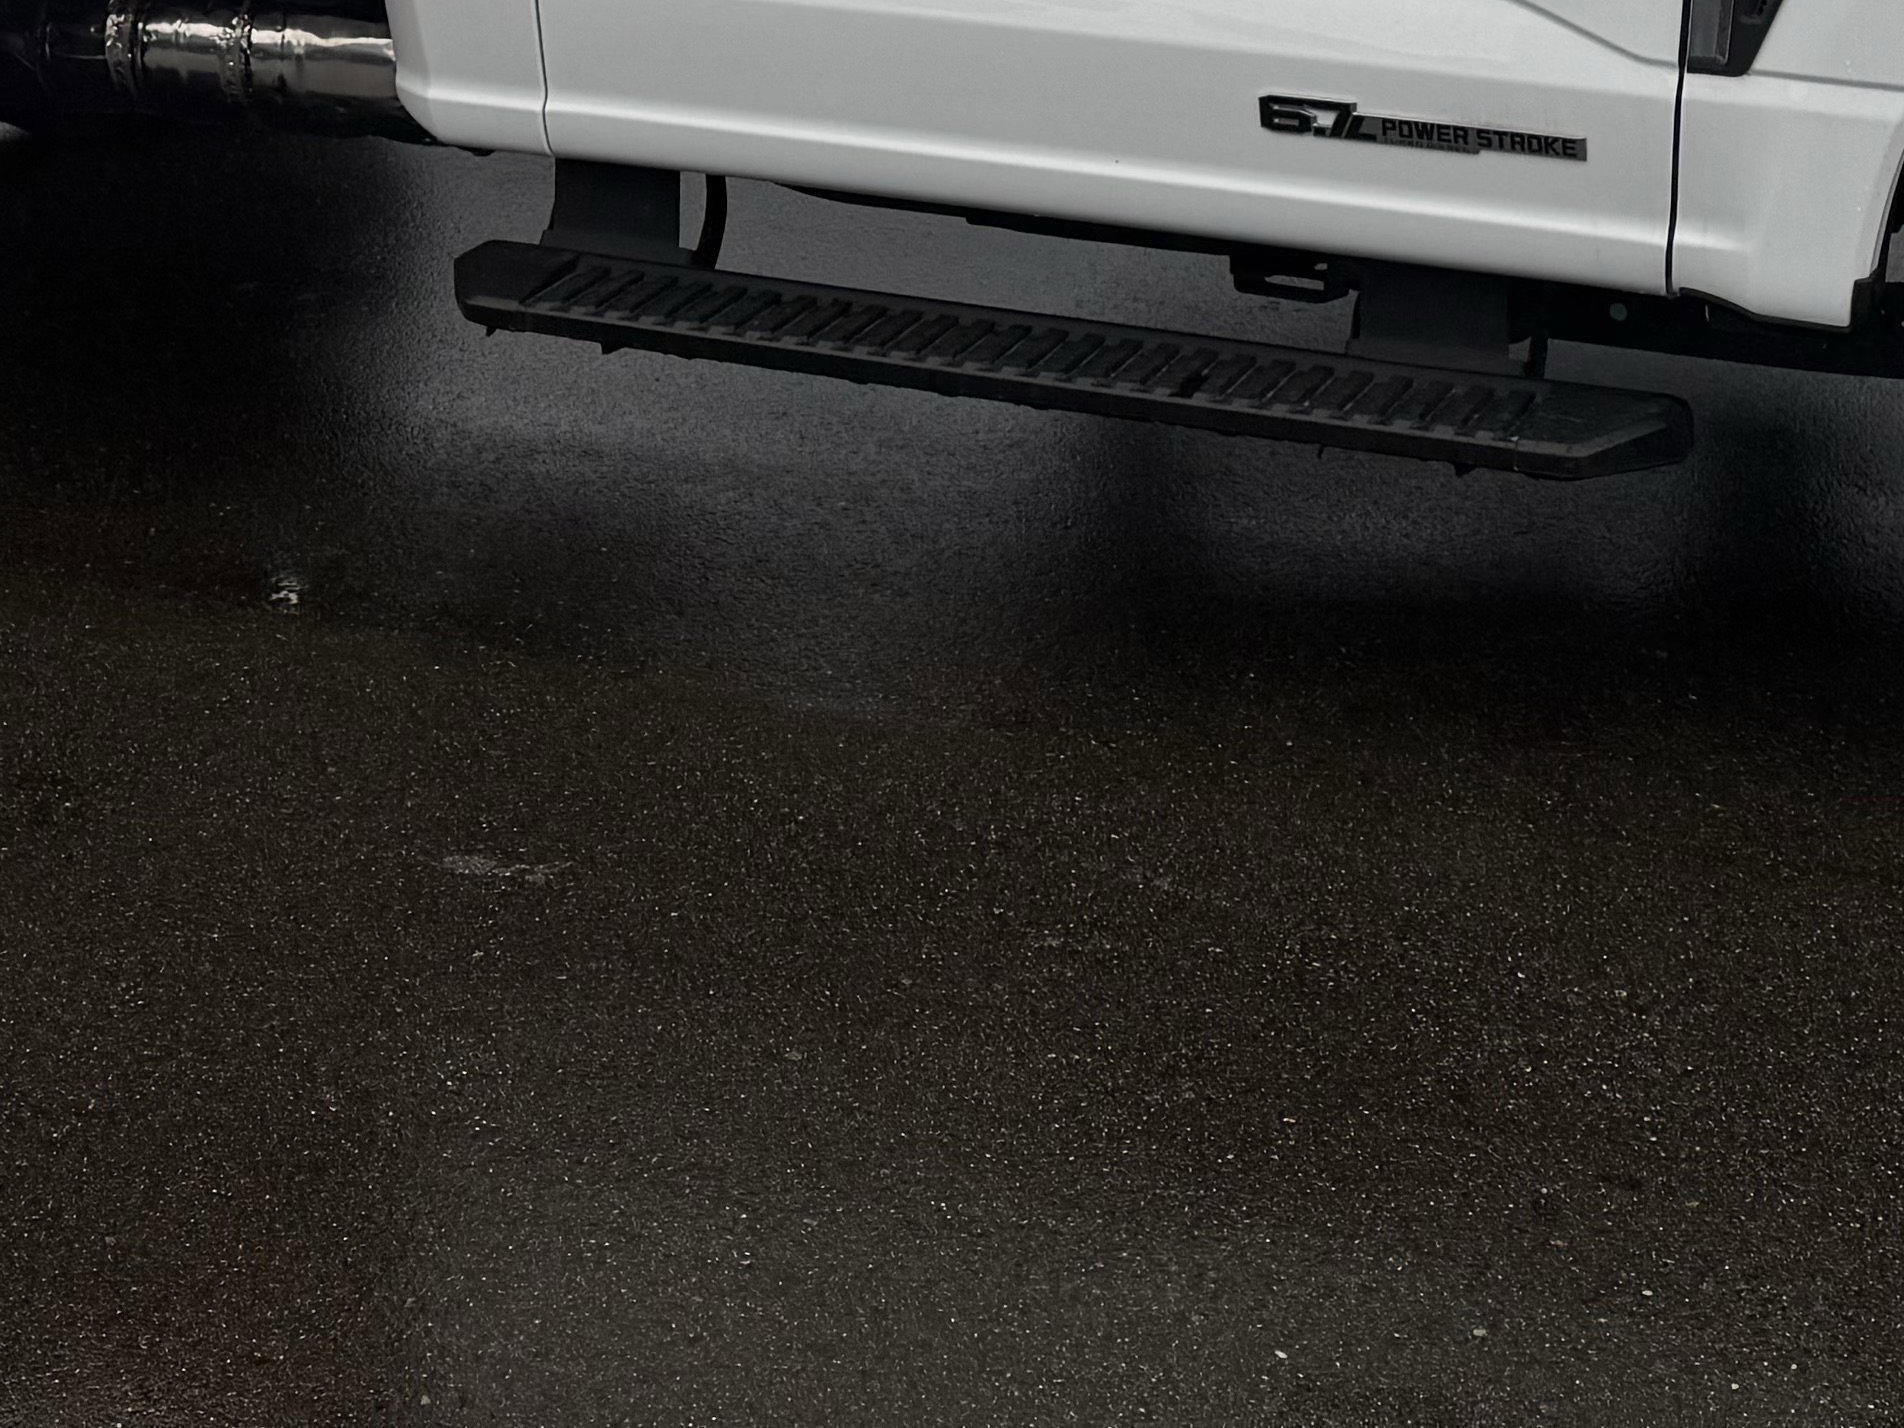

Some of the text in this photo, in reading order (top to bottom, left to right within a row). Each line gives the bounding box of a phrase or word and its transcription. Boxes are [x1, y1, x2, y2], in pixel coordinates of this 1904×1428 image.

[1259, 94, 1578, 158] 6.7L POWER STROKE
